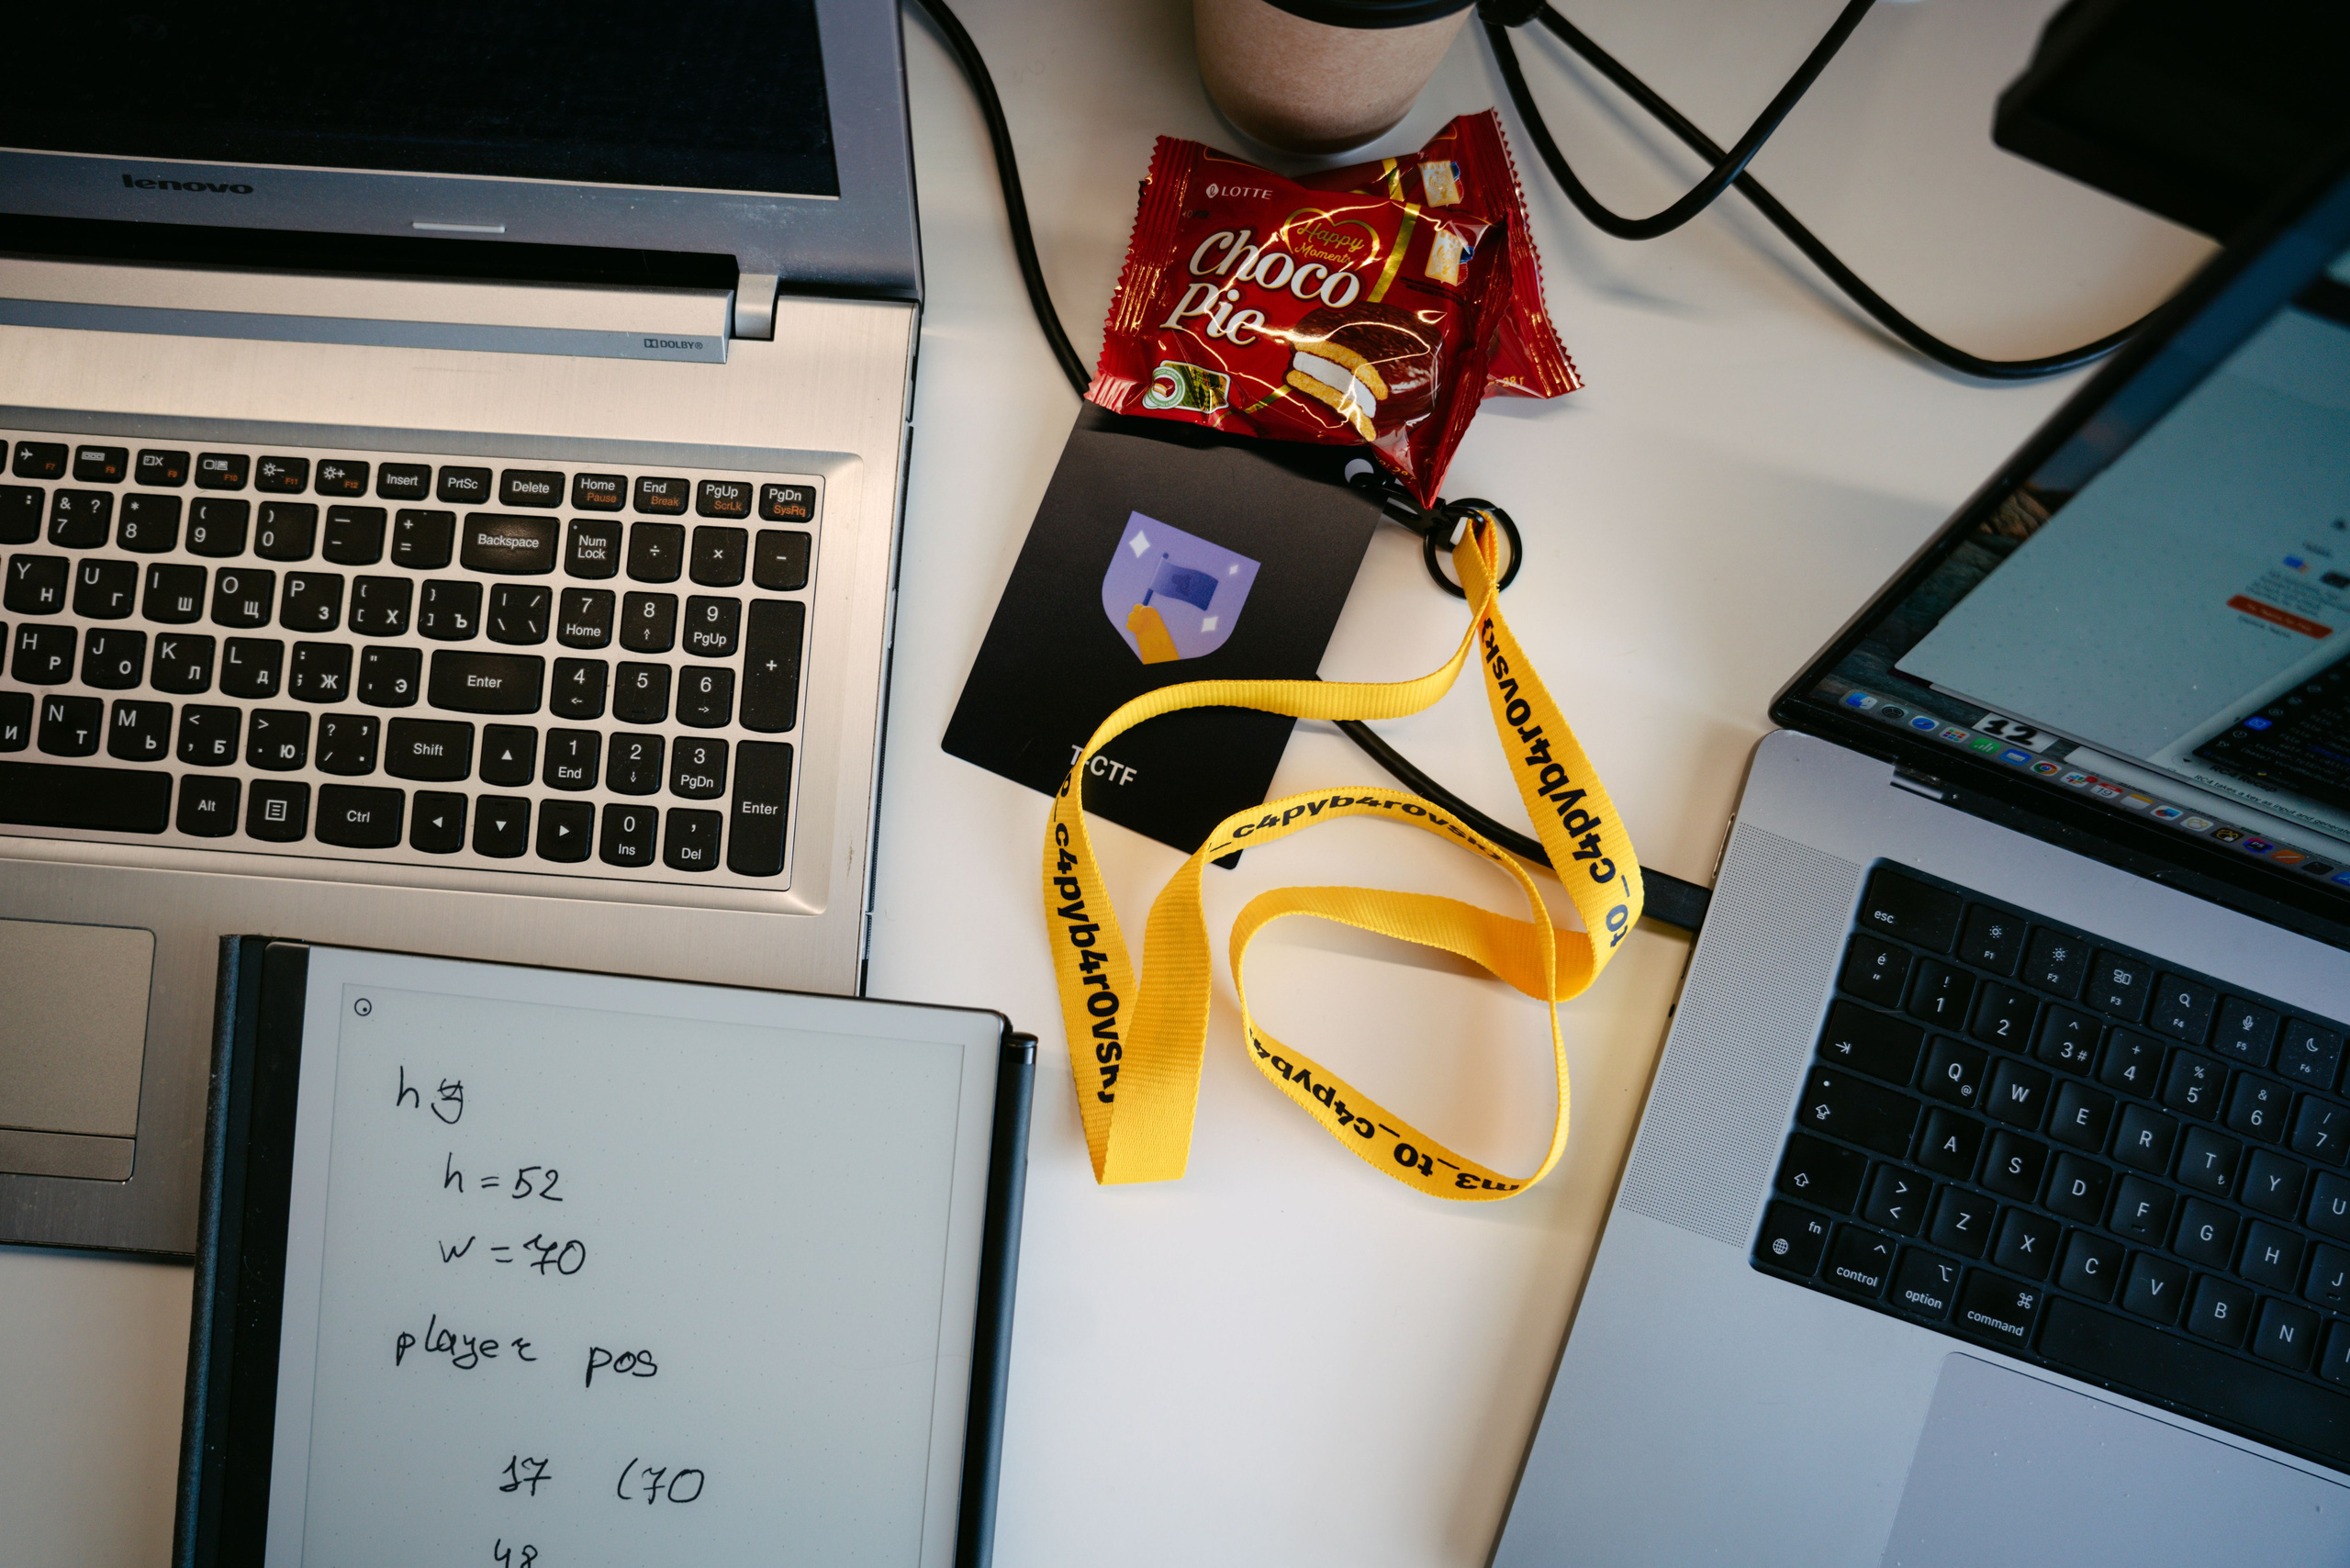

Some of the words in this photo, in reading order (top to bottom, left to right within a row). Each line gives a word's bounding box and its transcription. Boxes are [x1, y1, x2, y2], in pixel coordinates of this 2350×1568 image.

[121, 174, 254, 194] lenovo
[1220, 185, 1274, 200] LOTTE
[1295, 219, 1365, 253] Happy
[1294, 242, 1353, 264] Moments
[1188, 229, 1361, 308] Choco
[1159, 282, 1267, 346] Pie
[387, 474, 418, 486] Insert
[448, 477, 477, 488] PrtSc
[513, 481, 549, 493] Delete
[581, 478, 615, 490] Home
[643, 482, 666, 493] End
[588, 492, 617, 502] Pause
[707, 485, 738, 498] PgUp
[769, 488, 801, 502] PgDn
[652, 496, 677, 506] Break
[715, 500, 741, 510] ScrLk
[774, 505, 806, 517] SysRq
[58, 519, 67, 532] 7
[126, 523, 137, 538] 8
[195, 527, 206, 542] 9
[478, 532, 539, 549] Backspace
[579, 535, 606, 546] Num
[578, 547, 605, 559] Lock
[17, 563, 30, 579] Y
[85, 567, 99, 584] U
[291, 580, 305, 597] P
[112, 593, 123, 606] Г
[178, 598, 192, 610] Ш
[582, 598, 592, 612] 7
[244, 601, 259, 618] Щ
[643, 602, 655, 617] 8
[708, 606, 718, 622] 9
[455, 614, 467, 628] Ъ
[566, 624, 600, 636] Home
[22, 633, 38, 650] H
[93, 638, 104, 654] J
[694, 632, 726, 646] PgUp
[162, 643, 176, 659] K
[230, 646, 241, 663] L
[188, 666, 200, 679] Л
[257, 671, 268, 684] Д
[574, 669, 585, 684] 4
[321, 675, 338, 689] Ж
[396, 679, 407, 692] Э
[467, 676, 502, 688] Enter
[637, 673, 648, 688] 5
[700, 677, 711, 692] 6
[49, 705, 63, 722] N
[118, 710, 136, 726] M
[6, 726, 17, 739] И
[1982, 718, 2039, 746] 12
[146, 735, 156, 749] Ь
[214, 740, 226, 754] Б
[414, 743, 442, 756] Shift
[570, 740, 576, 755] 1
[280, 745, 295, 758] Ю
[631, 745, 641, 759] 2
[694, 748, 705, 764] 3
[558, 767, 581, 778] End
[681, 775, 713, 789] PgDn
[198, 800, 216, 812] Alt
[2194, 774, 2214, 785] RC4
[2214, 782, 2237, 794] takes
[2244, 793, 2262, 803] key
[2273, 802, 2296, 815] input
[2297, 812, 2314, 823] and
[743, 801, 778, 814] Enter
[347, 811, 370, 823] Ctrl
[619, 844, 635, 855] Ins
[682, 847, 701, 859] Del
[1874, 911, 1894, 923] esc
[1877, 953, 1886, 965] é
[1985, 951, 1994, 959] F1
[2047, 973, 2058, 982] F2
[1937, 998, 1943, 1012] 1
[2110, 997, 2121, 1005] F3
[1998, 1020, 2009, 1036] 2
[2174, 1019, 2184, 1027] F4
[2061, 1042, 2073, 1058] 3
[2236, 1042, 2246, 1050] F5
[1949, 1063, 1962, 1081] Q
[2124, 1066, 2135, 1080] 4
[2300, 1064, 2310, 1072] F6
[2012, 1084, 2029, 1102] W
[2188, 1087, 2199, 1103] 5
[2076, 1108, 2088, 1125] E
[2252, 1110, 2262, 1125] 6
[1944, 1137, 1955, 1152] A
[2140, 1130, 2152, 1147] R
[2317, 1132, 2327, 1147] 7
[2009, 1158, 2021, 1173] S
[2206, 1153, 2216, 1168] T
[2072, 1180, 2086, 1195] D
[2270, 1176, 2280, 1191] Y
[2137, 1203, 2149, 1216] F
[2333, 1198, 2346, 1215] U
[1809, 1222, 1820, 1234] fn
[1956, 1213, 1970, 1230] Z
[2200, 1225, 2213, 1240] G
[2020, 1235, 2035, 1252] X
[2266, 1247, 2279, 1264] H
[2086, 1259, 2098, 1273] C
[1837, 1267, 1877, 1286] control
[2332, 1272, 2343, 1286] J
[2152, 1279, 2163, 1295] V
[1906, 1291, 1942, 1308] option
[2215, 1303, 2227, 1318] B
[1968, 1311, 2023, 1336] command
[2279, 1325, 2293, 1342] N
[586, 1348, 659, 1388] pos
